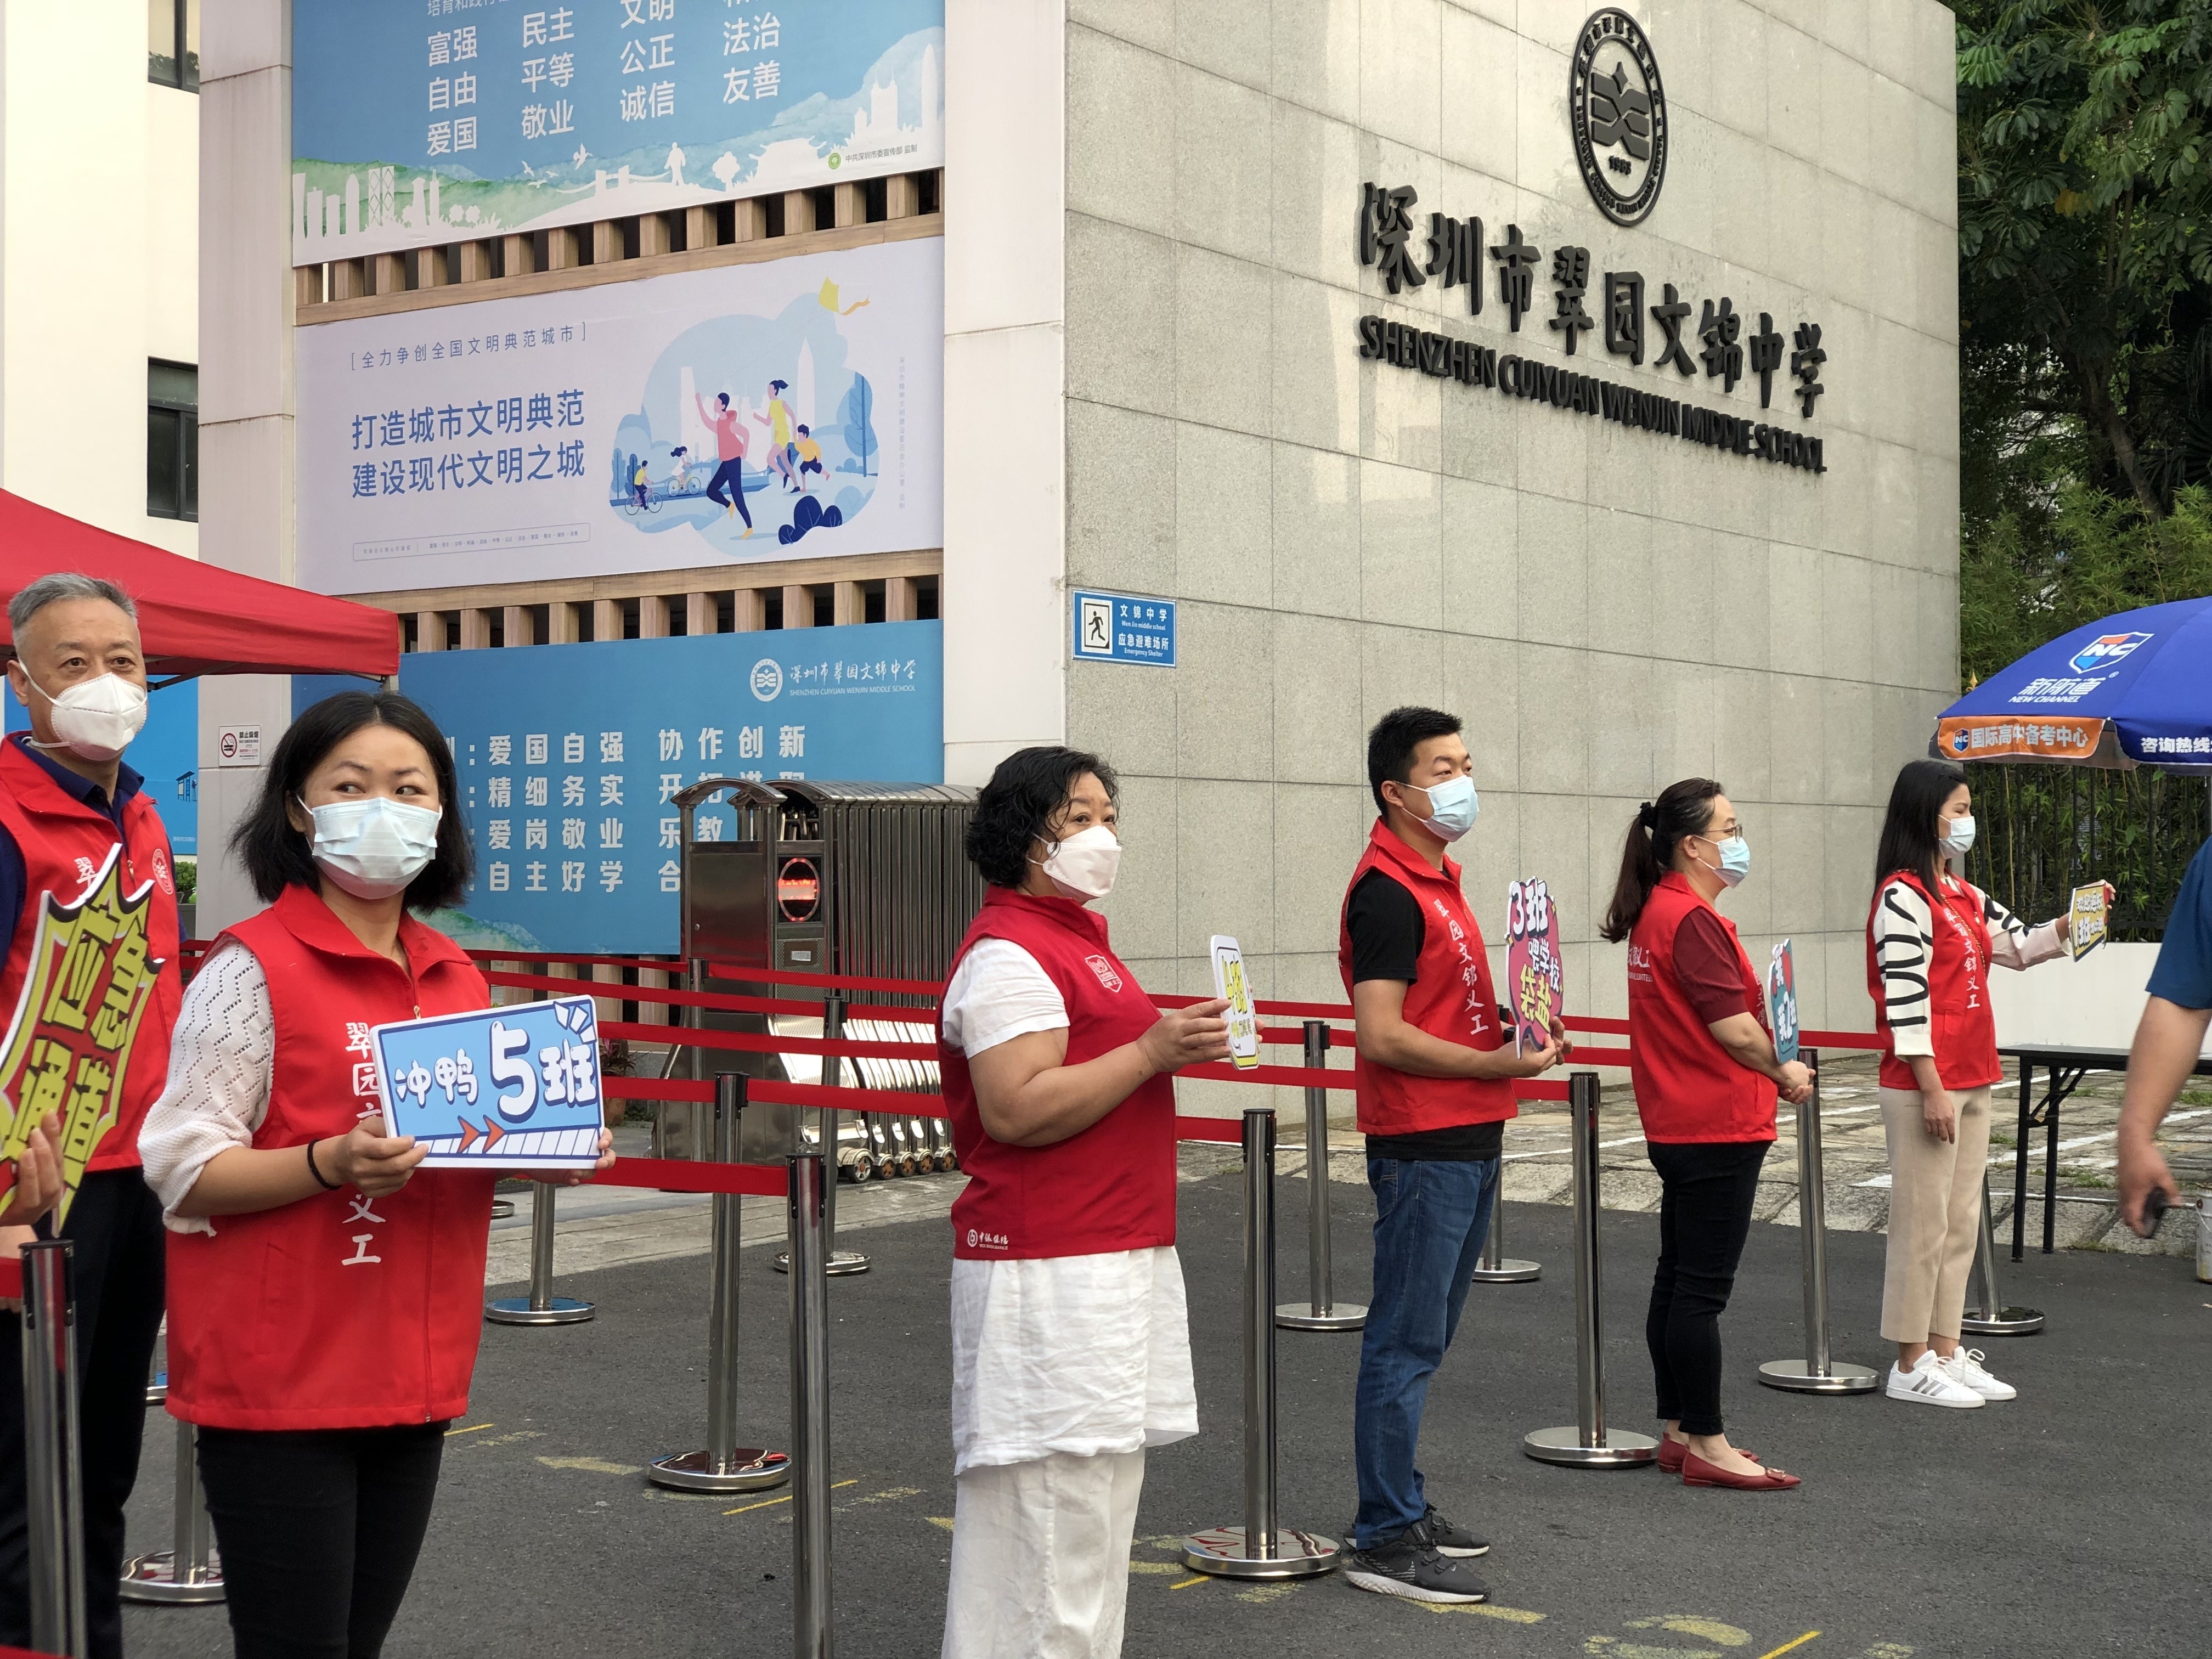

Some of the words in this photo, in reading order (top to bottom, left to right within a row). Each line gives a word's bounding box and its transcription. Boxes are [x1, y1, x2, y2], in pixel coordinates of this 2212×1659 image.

[428, 26, 477, 67] 富强
[523, 7, 574, 48] 民主
[620, 0, 674, 28] 文明
[429, 71, 476, 112] 自由
[522, 52, 574, 93] 平等
[620, 33, 675, 74] 公正
[723, 12, 781, 56] 法治
[427, 116, 477, 157] 爱国
[522, 99, 574, 139] 敬业
[620, 81, 675, 122] 诚信
[723, 60, 781, 104] 友善
[845, 146, 903, 163] 中共深圳市委宣传部
[1361, 182, 1827, 418] 深圳市翠园文锦中学
[1360, 315, 1496, 388] SHENZHEN
[1498, 354, 1600, 415] CUIYUAN
[1600, 381, 1681, 436] WENJIN
[1681, 403, 1754, 455] MIDDLE
[1754, 423, 1828, 473] SCHOOL
[352, 388, 585, 450] 打造城市文明典范
[352, 439, 585, 498] 建设现代文明之城
[1120, 604, 1167, 622] 文锦中学
[1119, 633, 1169, 651] 应急避难场所
[1124, 647, 1147, 657] Emergency
[2090, 642, 2139, 657] NC
[790, 659, 916, 685] 深圳市翠园文锦中学
[2018, 677, 2107, 696] 新航道
[2008, 695, 2034, 703] NEW
[2033, 695, 2082, 704] CHANNEL
[658, 725, 806, 761] 协作创新
[1955, 735, 1968, 743] NC
[1971, 723, 2088, 749] 国际高中备考中心
[1511, 877, 1549, 936] 3班
[1434, 899, 1489, 1036] 翠园文锦义工
[1944, 907, 1980, 1009] 翠园文锦义工
